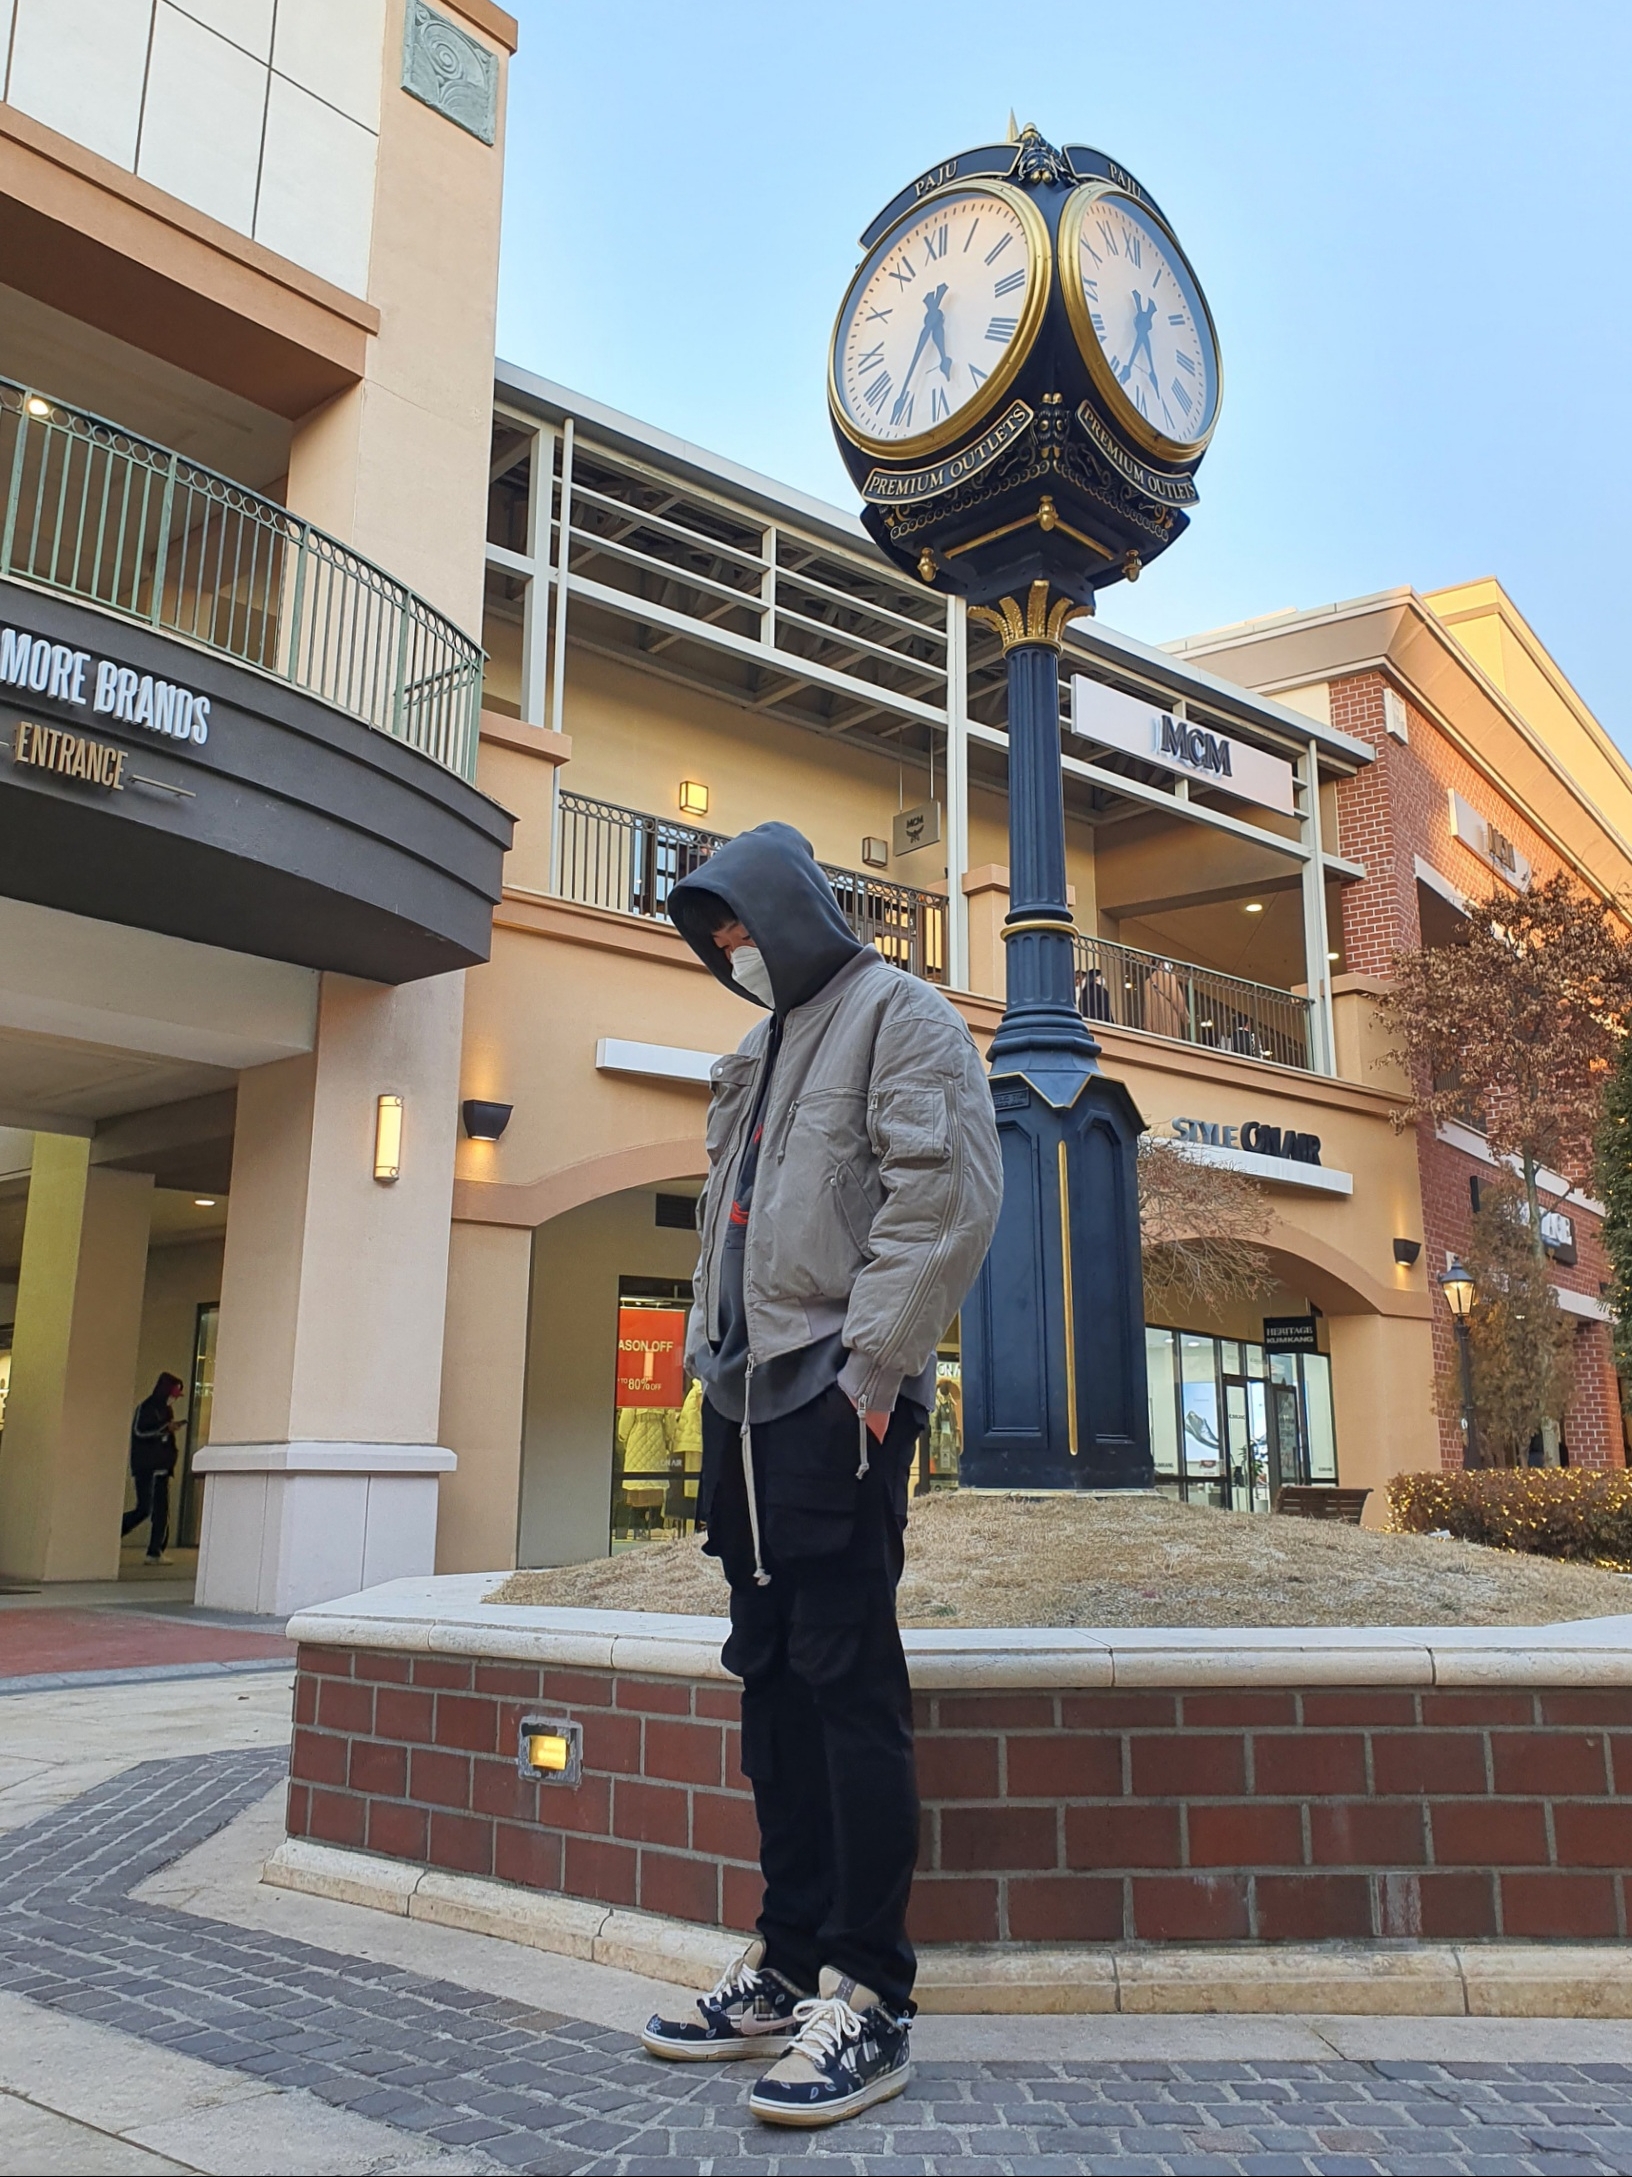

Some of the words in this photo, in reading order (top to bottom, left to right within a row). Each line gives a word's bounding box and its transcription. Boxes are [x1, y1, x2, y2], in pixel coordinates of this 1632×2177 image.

[914, 161, 958, 197] PAJU
[1108, 163, 1142, 199] PAJU
[923, 223, 948, 267] XII
[868, 469, 944, 497] PREMIUM
[950, 408, 1027, 478] OUTLETS
[1084, 407, 1145, 484] PREMIUM
[1147, 475, 1196, 500] OUTLETS
[0, 628, 91, 706] MORE
[93, 660, 211, 746] BRANDS
[15, 721, 129, 791] ENTRANCE
[1161, 714, 1233, 778] MCM
[906, 815, 924, 829] MCM
[1172, 1117, 1239, 1150] STYLE
[651, 1340, 674, 1353] OFF
[1266, 1326, 1313, 1336] HERITAGE
[1266, 1336, 1314, 1344] KUMKANG
[628, 1378, 650, 1391] 80%
